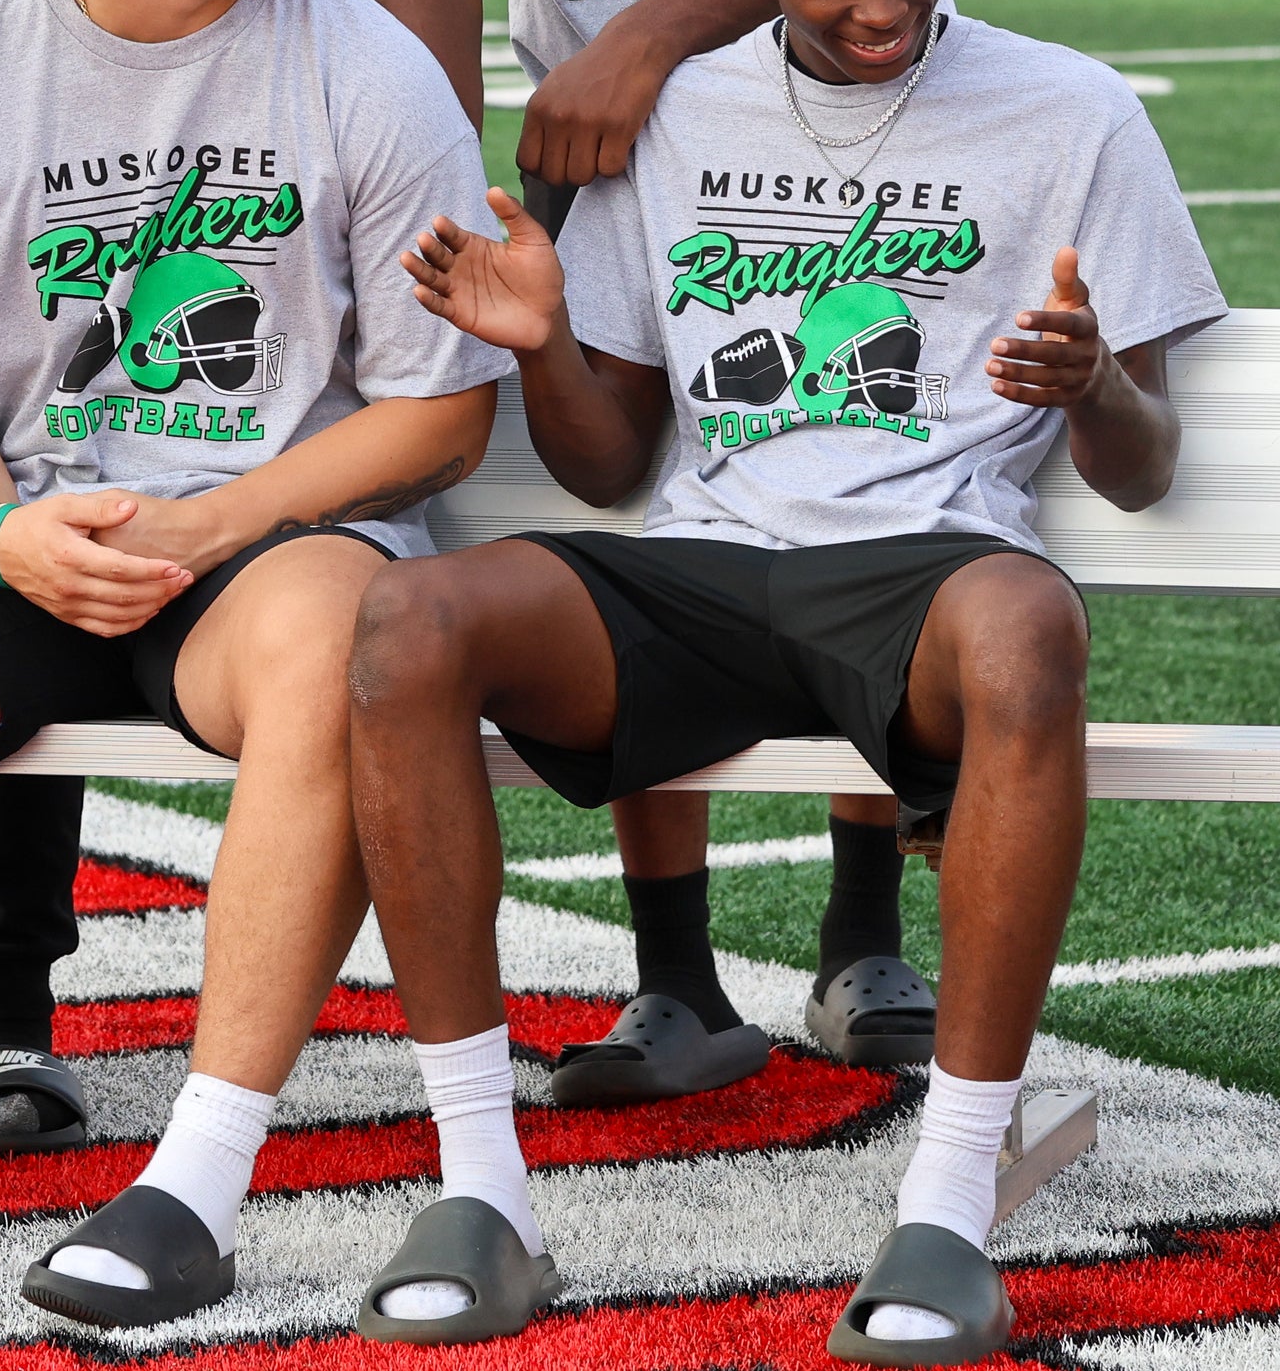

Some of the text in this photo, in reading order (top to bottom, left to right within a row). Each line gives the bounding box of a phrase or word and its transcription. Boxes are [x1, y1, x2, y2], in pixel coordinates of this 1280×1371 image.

[43, 145, 276, 194] MUSKOGEE
[700, 170, 961, 212] MUSKOGEE
[666, 202, 985, 318] Roughers
[45, 395, 264, 441] FOOTBALL
[698, 408, 931, 452] FOOTBALL
